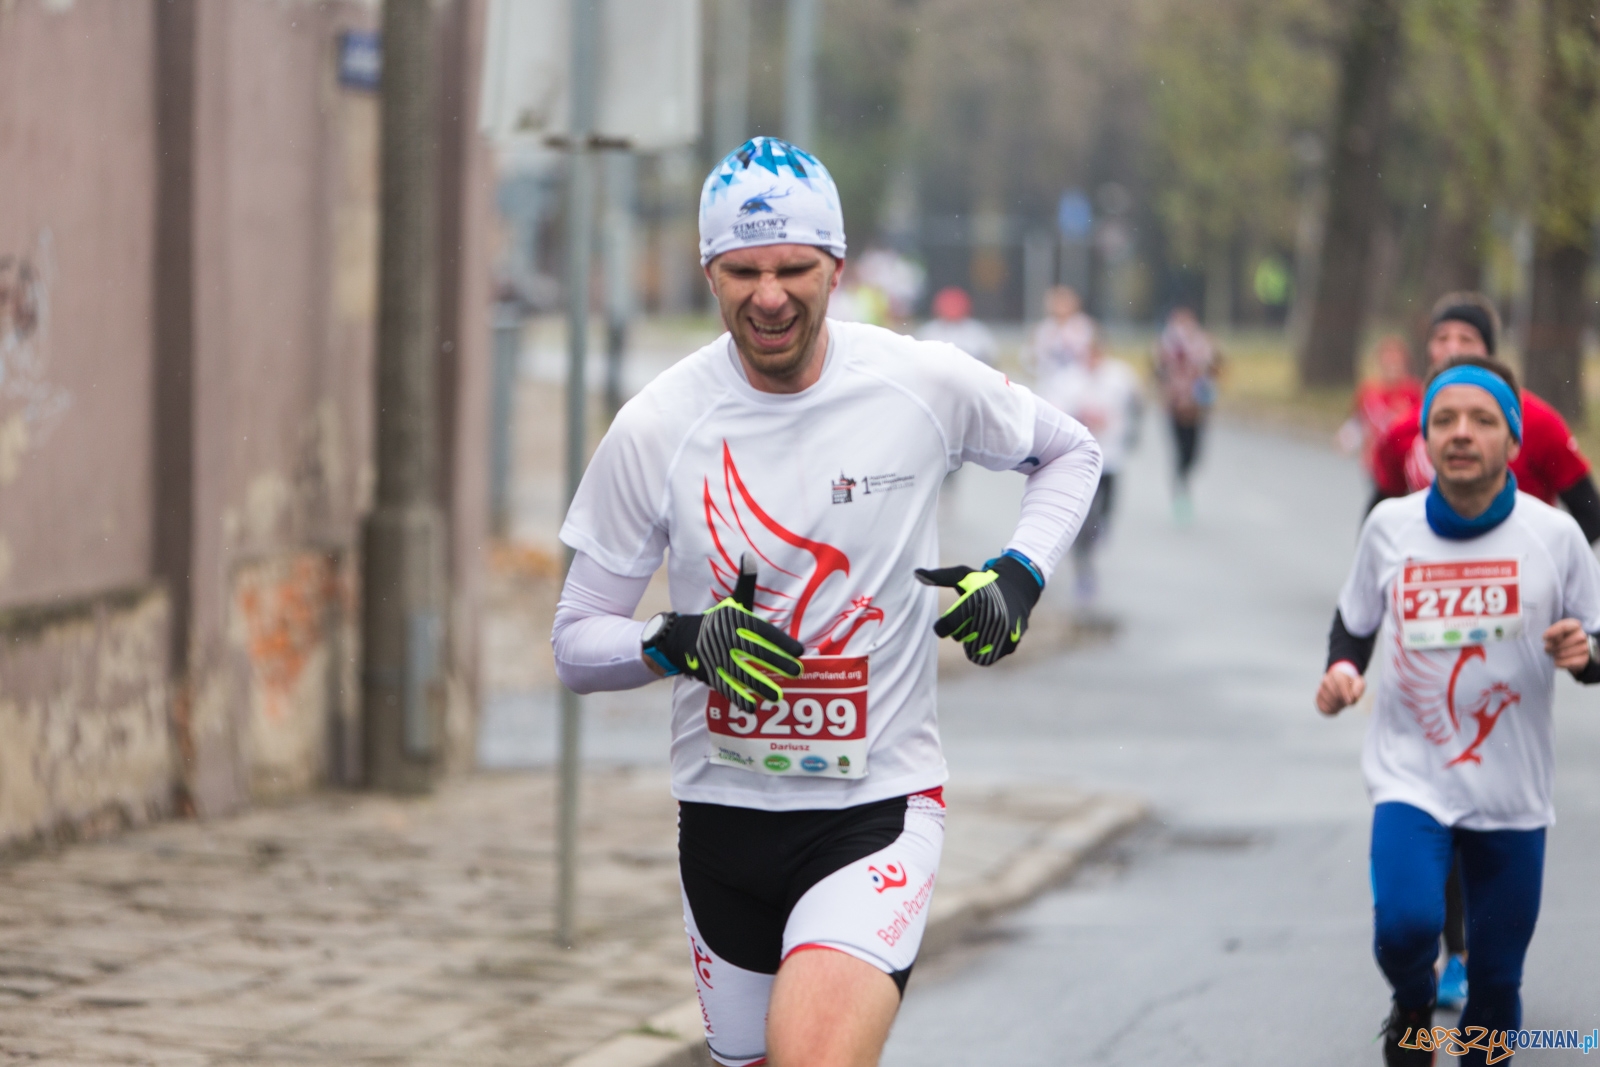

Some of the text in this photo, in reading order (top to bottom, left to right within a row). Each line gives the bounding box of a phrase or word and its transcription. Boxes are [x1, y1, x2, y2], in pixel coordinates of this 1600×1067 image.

[732, 218, 788, 233] ZIMOWY
[861, 476, 871, 494] 1
[1417, 586, 1507, 618] 2749
[709, 698, 857, 736] B 5299
[770, 742, 810, 752] Dariusz
[877, 910, 910, 948] Bank
